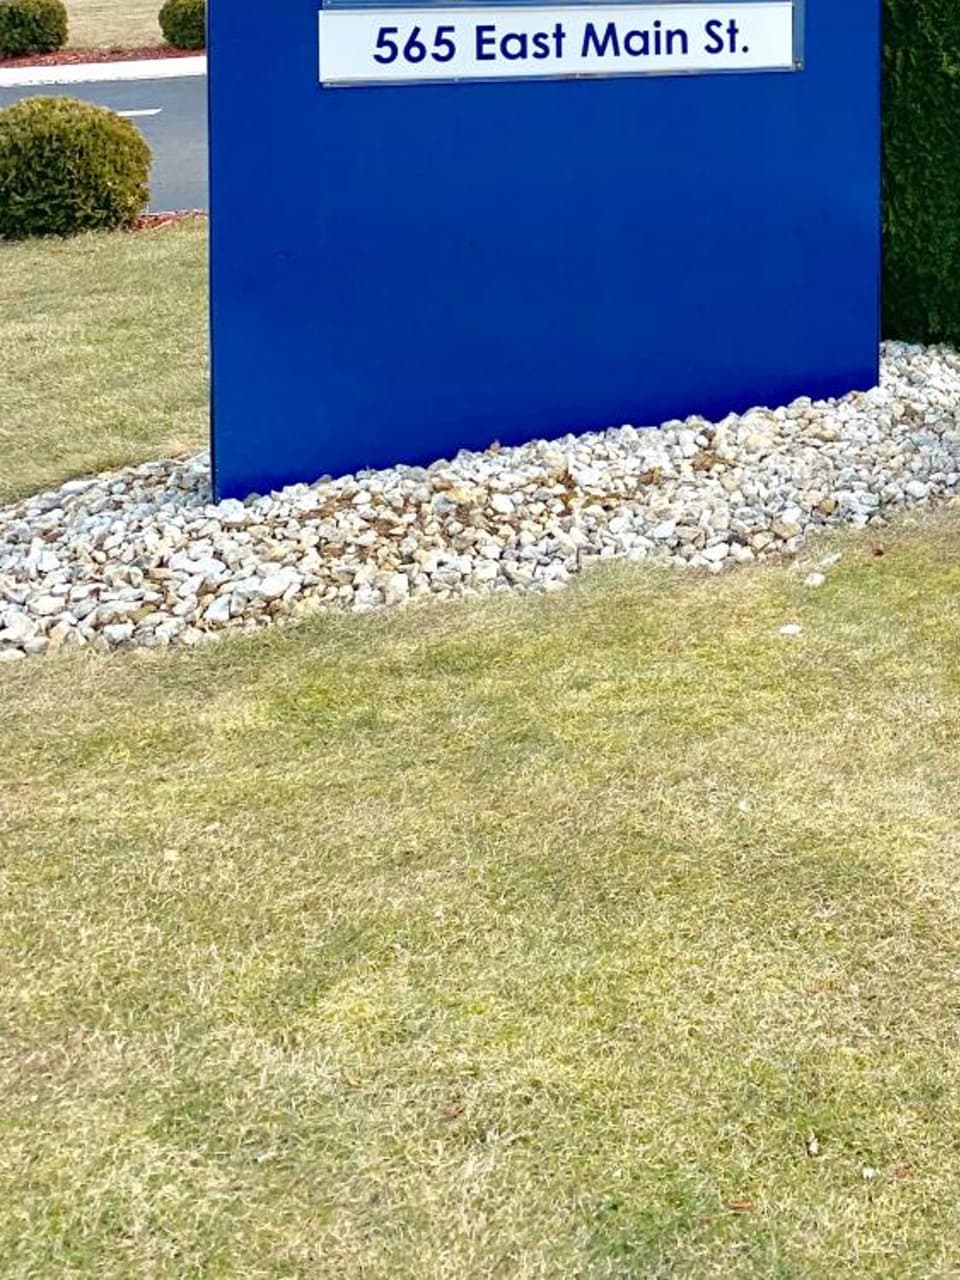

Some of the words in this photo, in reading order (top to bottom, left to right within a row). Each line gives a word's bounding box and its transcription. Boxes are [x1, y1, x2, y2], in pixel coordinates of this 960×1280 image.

[373, 25, 456, 65] 565
[475, 23, 566, 61] East
[581, 19, 689, 58] Main
[704, 19, 749, 55] St.
